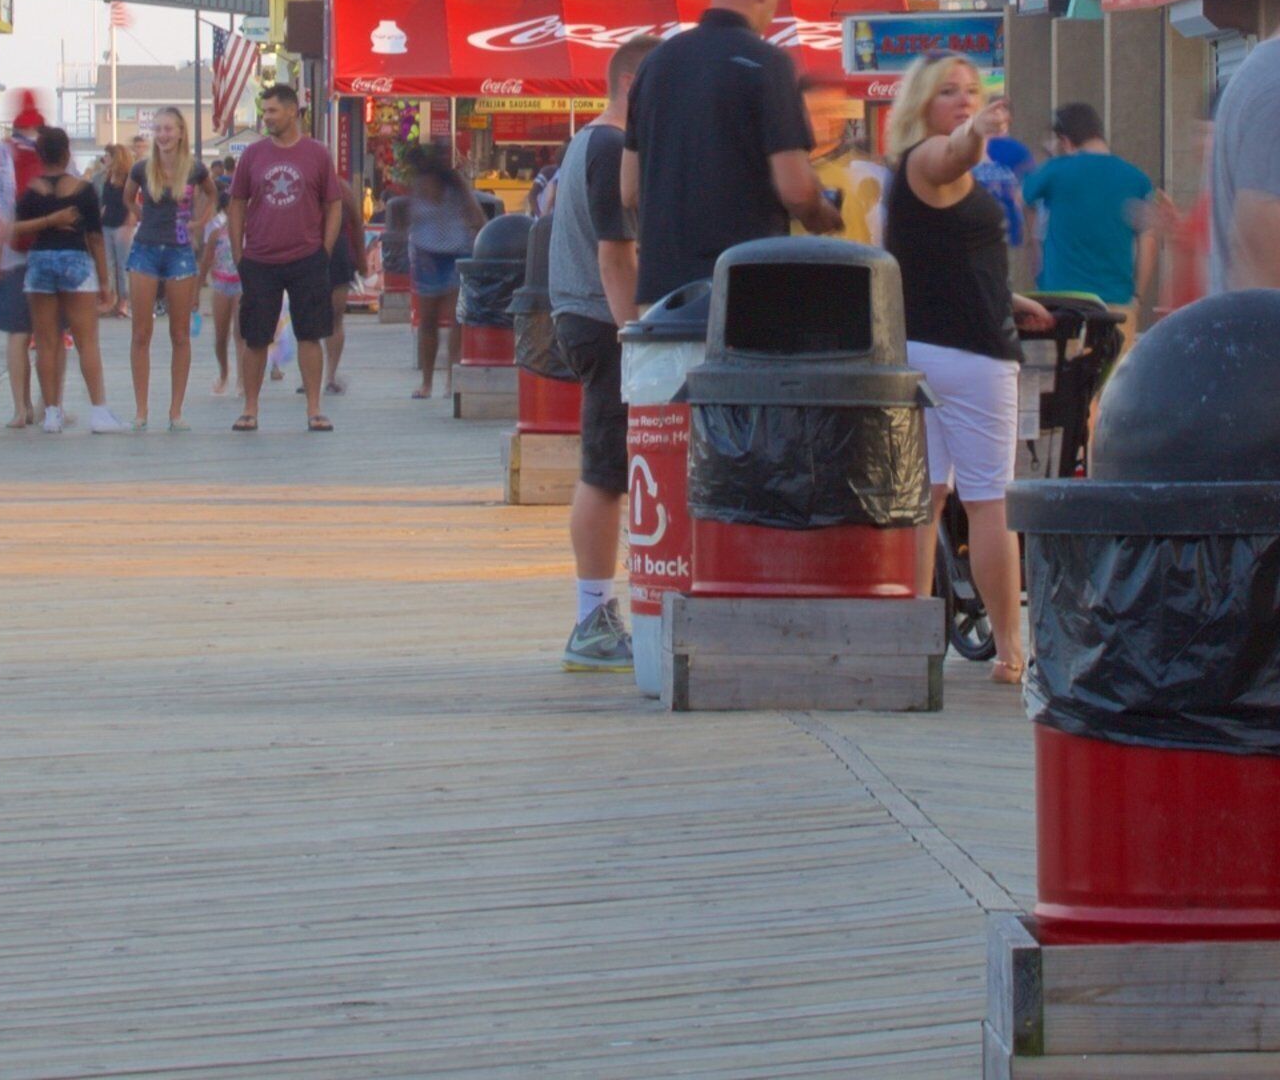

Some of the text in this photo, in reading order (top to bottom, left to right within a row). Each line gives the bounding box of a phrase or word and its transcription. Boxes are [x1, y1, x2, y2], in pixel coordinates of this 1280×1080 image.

[881, 35, 943, 55] AZTEC
[948, 33, 991, 53] BAR
[351, 77, 393, 93] Coca-Cola
[480, 78, 523, 94] Coca-Cola
[868, 80, 905, 96] Coca-C
[480, 100, 506, 109] ITALIAN
[509, 100, 541, 109] SAUSAGE
[574, 100, 594, 109] CORN
[641, 414, 685, 429] Recycle
[645, 553, 689, 577] back
